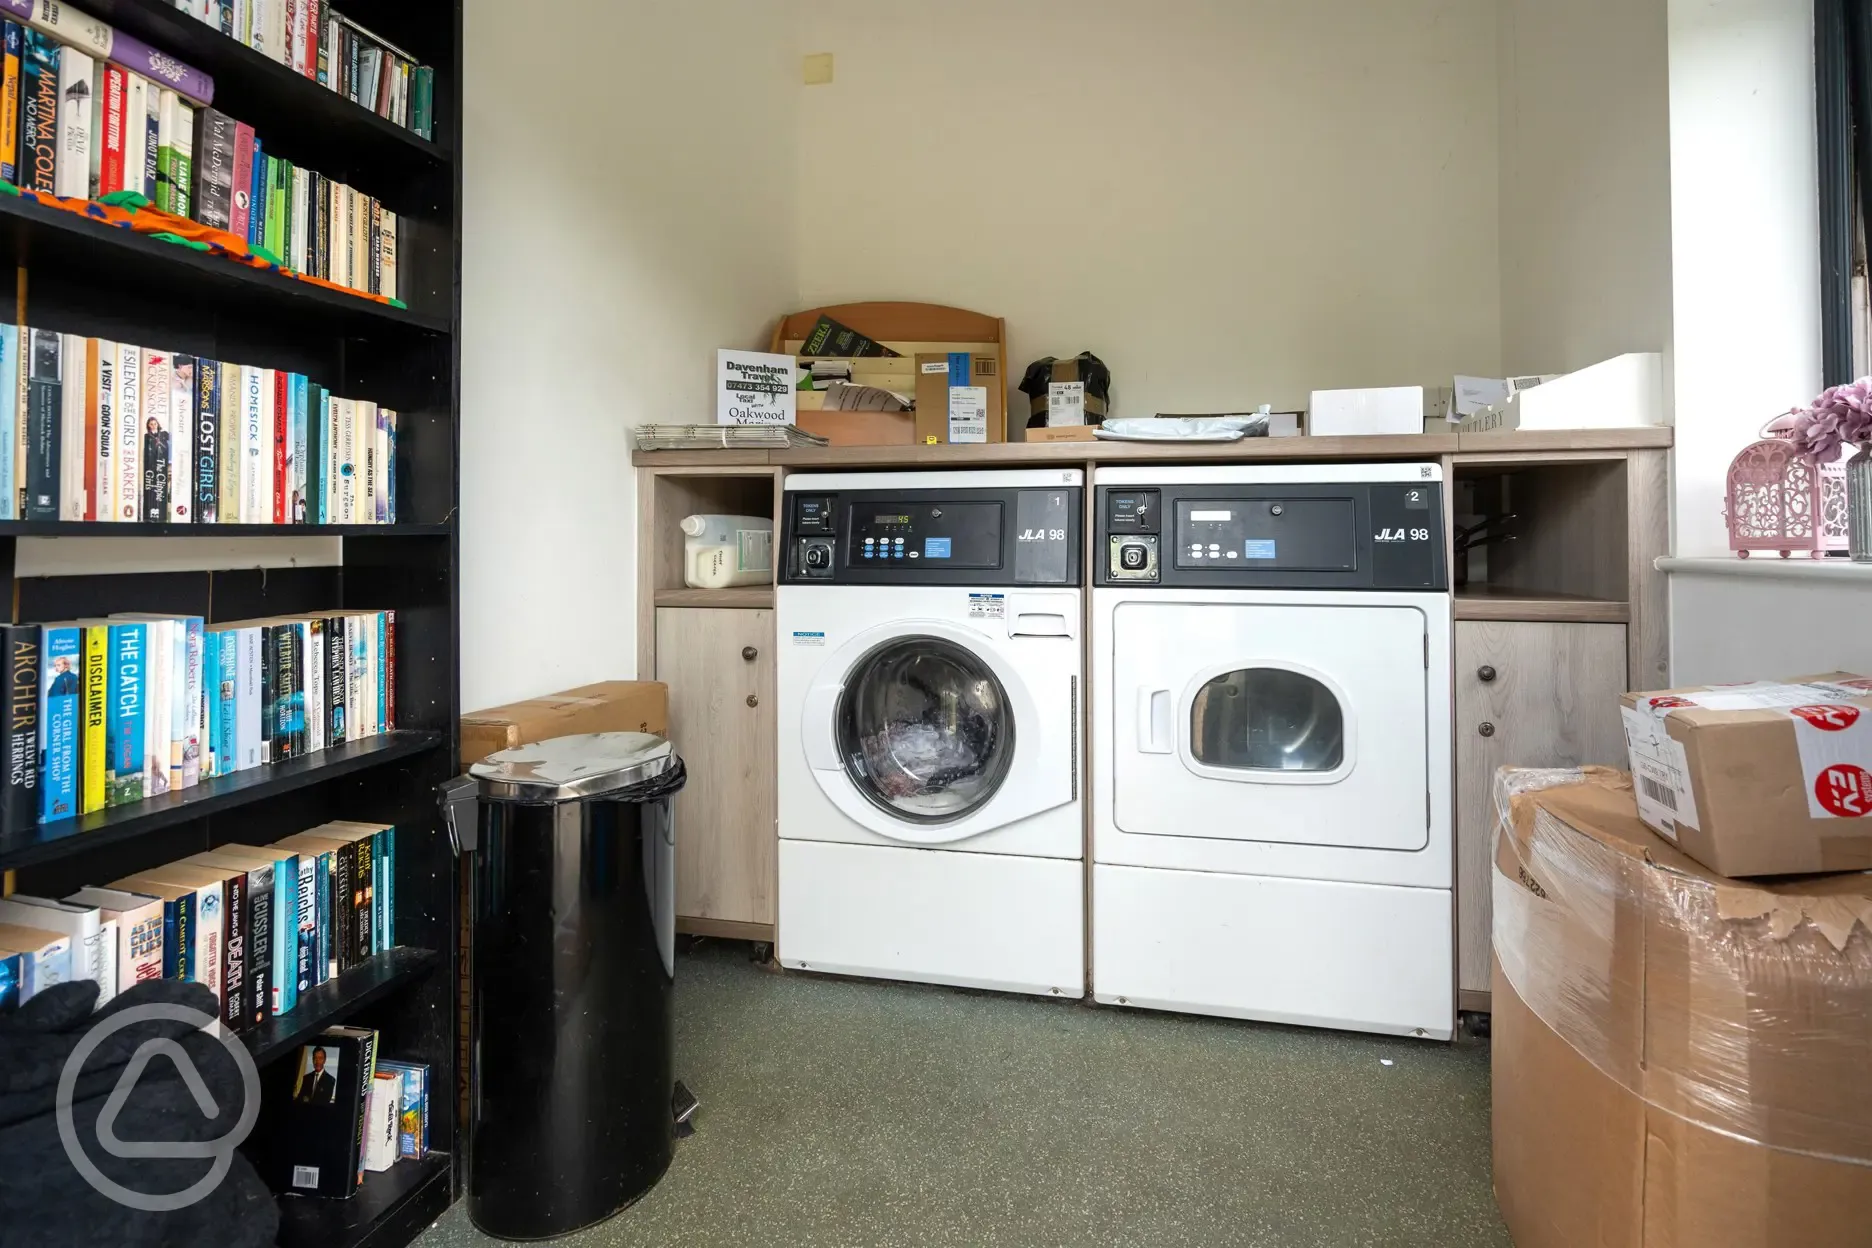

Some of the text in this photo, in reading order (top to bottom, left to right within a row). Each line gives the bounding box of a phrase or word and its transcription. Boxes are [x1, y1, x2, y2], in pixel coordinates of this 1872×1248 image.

[6, 75, 16, 100] Nepal
[26, 96, 36, 151] NO MERCY
[108, 69, 121, 152] OPERATION FORTITUDE
[35, 68, 56, 190] MARTINA COLE
[75, 126, 84, 158] DEVIL
[148, 130, 157, 157] JUNOT
[178, 160, 187, 188] LIANE
[210, 120, 224, 197] Val McDermid
[102, 359, 112, 367] A
[123, 356, 135, 400] SILENCE
[726, 361, 788, 375] Davenham
[741, 371, 774, 381] Travel
[101, 369, 113, 393] VISIT
[201, 365, 210, 409] MARSONS
[727, 382, 787, 392] 07473 354 929
[101, 405, 111, 428] GOON
[177, 399, 187, 434] Sylvester
[249, 375, 259, 441] HOMESICK
[729, 407, 785, 421] Oakwood
[100, 429, 110, 458] SQUAD
[123, 415, 135, 446] GIRLS
[344, 430, 352, 461] GERRITSEN
[200, 412, 214, 502] LOST GIRLS
[123, 457, 134, 501] BARKER
[145, 470, 154, 490] Girls
[151, 459, 167, 501] The Clippie
[1055, 497, 1060, 506] 1
[1410, 491, 1420, 502] 2
[1018, 529, 1065, 540] JLA 98
[1374, 528, 1429, 541] JLA 98
[188, 623, 199, 648] Nora
[188, 650, 197, 690] Roberts
[225, 635, 236, 678] JOSEPHINE
[279, 632, 292, 705] WILBUR SMITH
[13, 641, 36, 730] ARCHER
[120, 629, 139, 718] THE CATCH
[312, 675, 320, 695] Tope
[89, 654, 102, 728] DISCLAIMER
[52, 713, 62, 781] CORNER SHOP
[61, 698, 72, 794] THE GIRL FROM THE
[223, 727, 231, 748] Shine
[11, 734, 24, 785] HERRINGS
[24, 730, 36, 788] TWELVE RED
[123, 740, 132, 769] LOGAN
[338, 856, 347, 902] GEISHA
[298, 875, 314, 924] Reichs
[130, 927, 162, 947] CROW
[132, 916, 162, 936] AS THE
[178, 916, 187, 955] CAMELOT
[231, 929, 238, 937] OF
[253, 901, 267, 956] CUSSLER
[131, 941, 162, 959] FLIES
[209, 931, 217, 967] FORGOTTEN
[227, 936, 243, 991] DEATH
[233, 992, 241, 1016] ROBERT
[256, 973, 264, 1008] Polar Shift
[228, 996, 236, 1020] LYMAN
[361, 1041, 373, 1096] DICK FRANCIS
